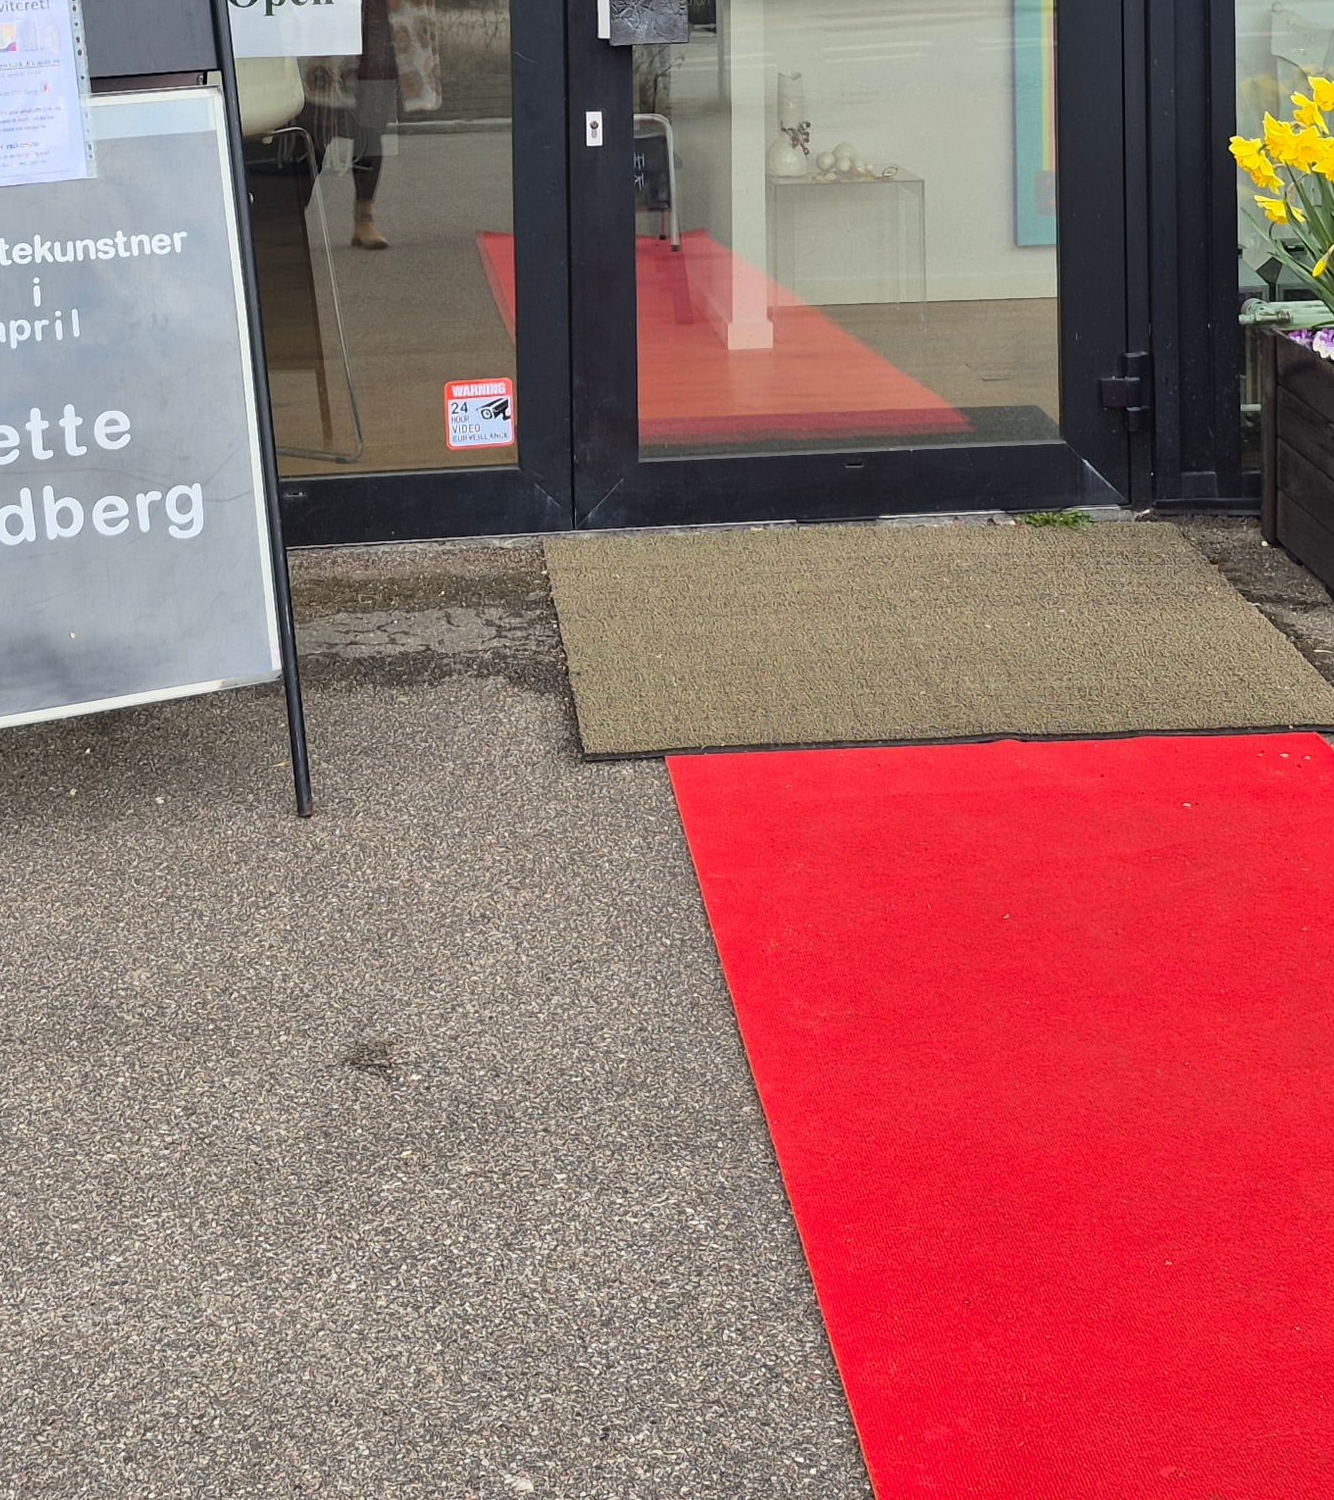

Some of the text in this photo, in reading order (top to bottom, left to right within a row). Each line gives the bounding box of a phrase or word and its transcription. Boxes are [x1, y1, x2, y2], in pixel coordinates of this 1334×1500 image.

[33, 277, 42, 307] i
[451, 381, 507, 398] WARNING
[451, 401, 468, 415] 24
[451, 415, 470, 424] HOUR
[451, 423, 481, 434] VIDEO
